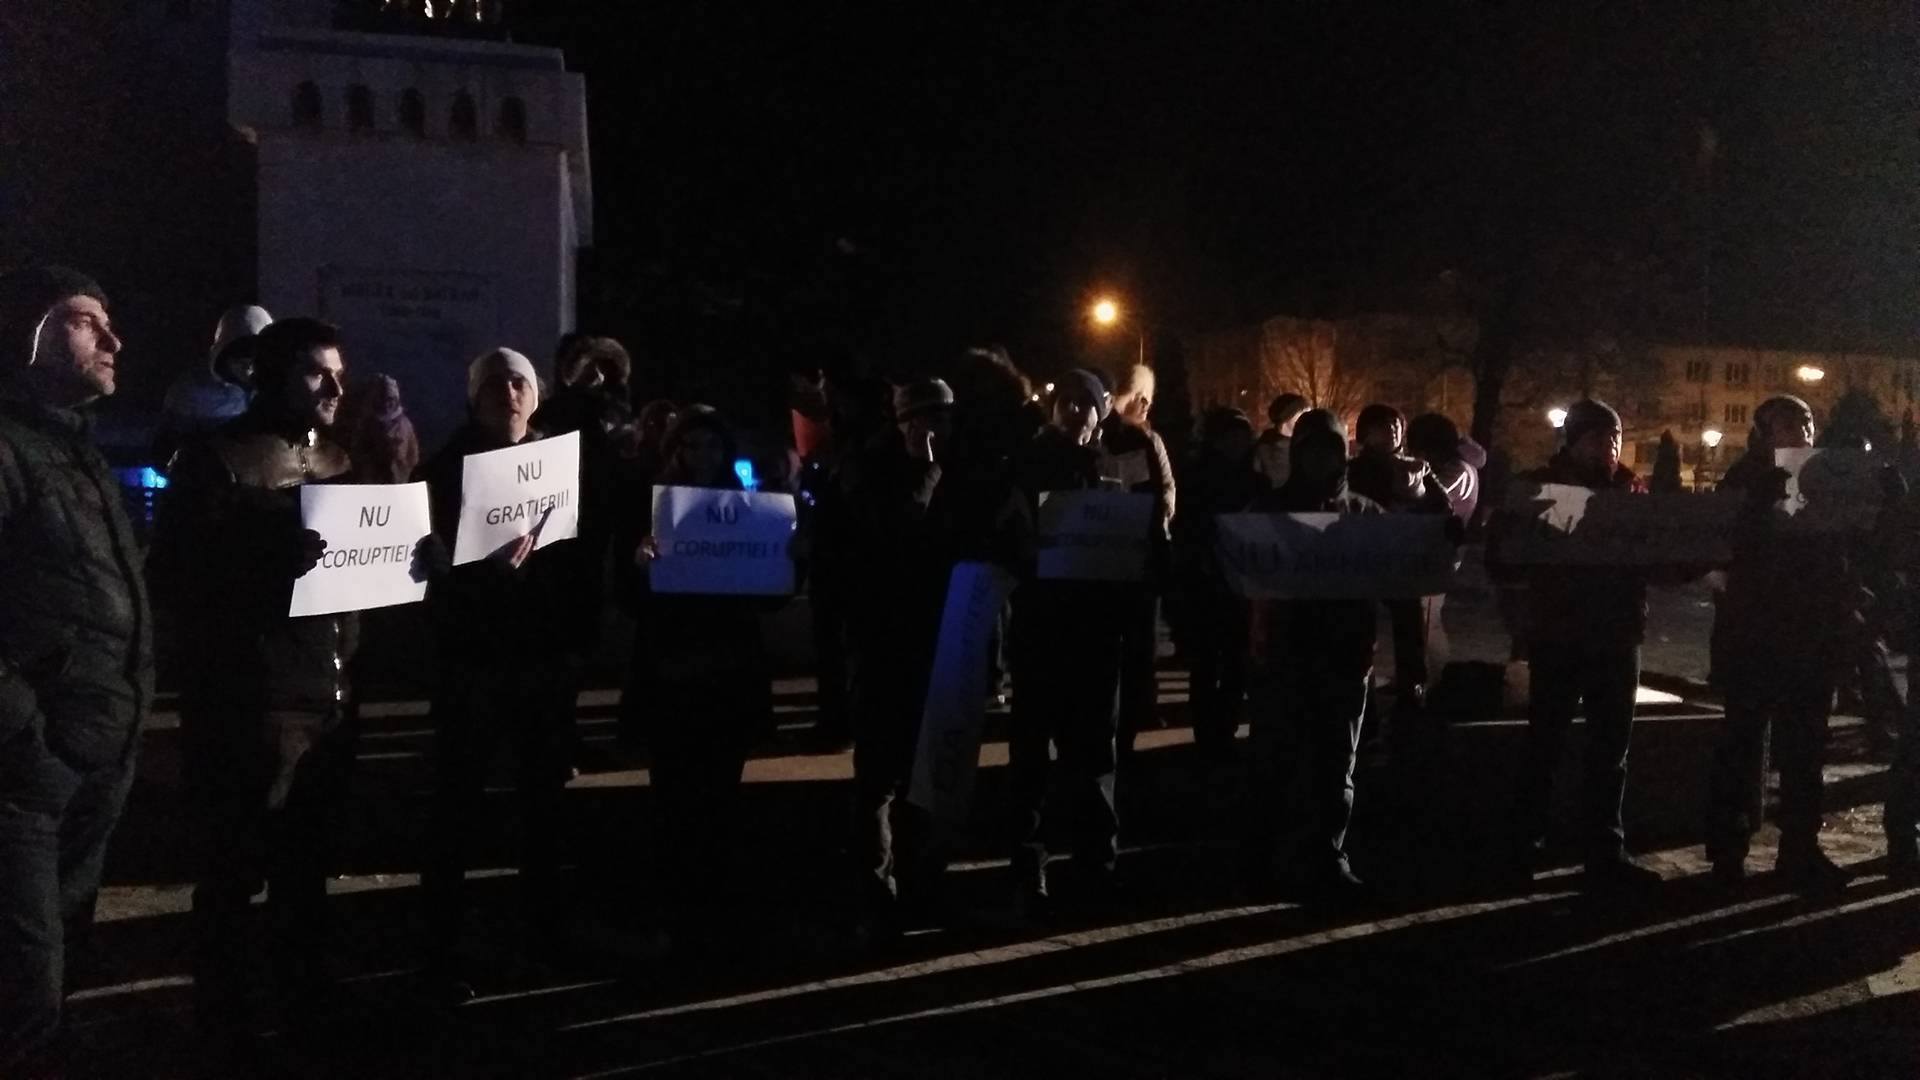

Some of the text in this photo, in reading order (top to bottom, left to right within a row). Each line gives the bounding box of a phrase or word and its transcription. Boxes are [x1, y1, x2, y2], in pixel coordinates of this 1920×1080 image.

[517, 459, 542, 484] NU
[359, 505, 391, 528] NU
[706, 505, 738, 524] NU
